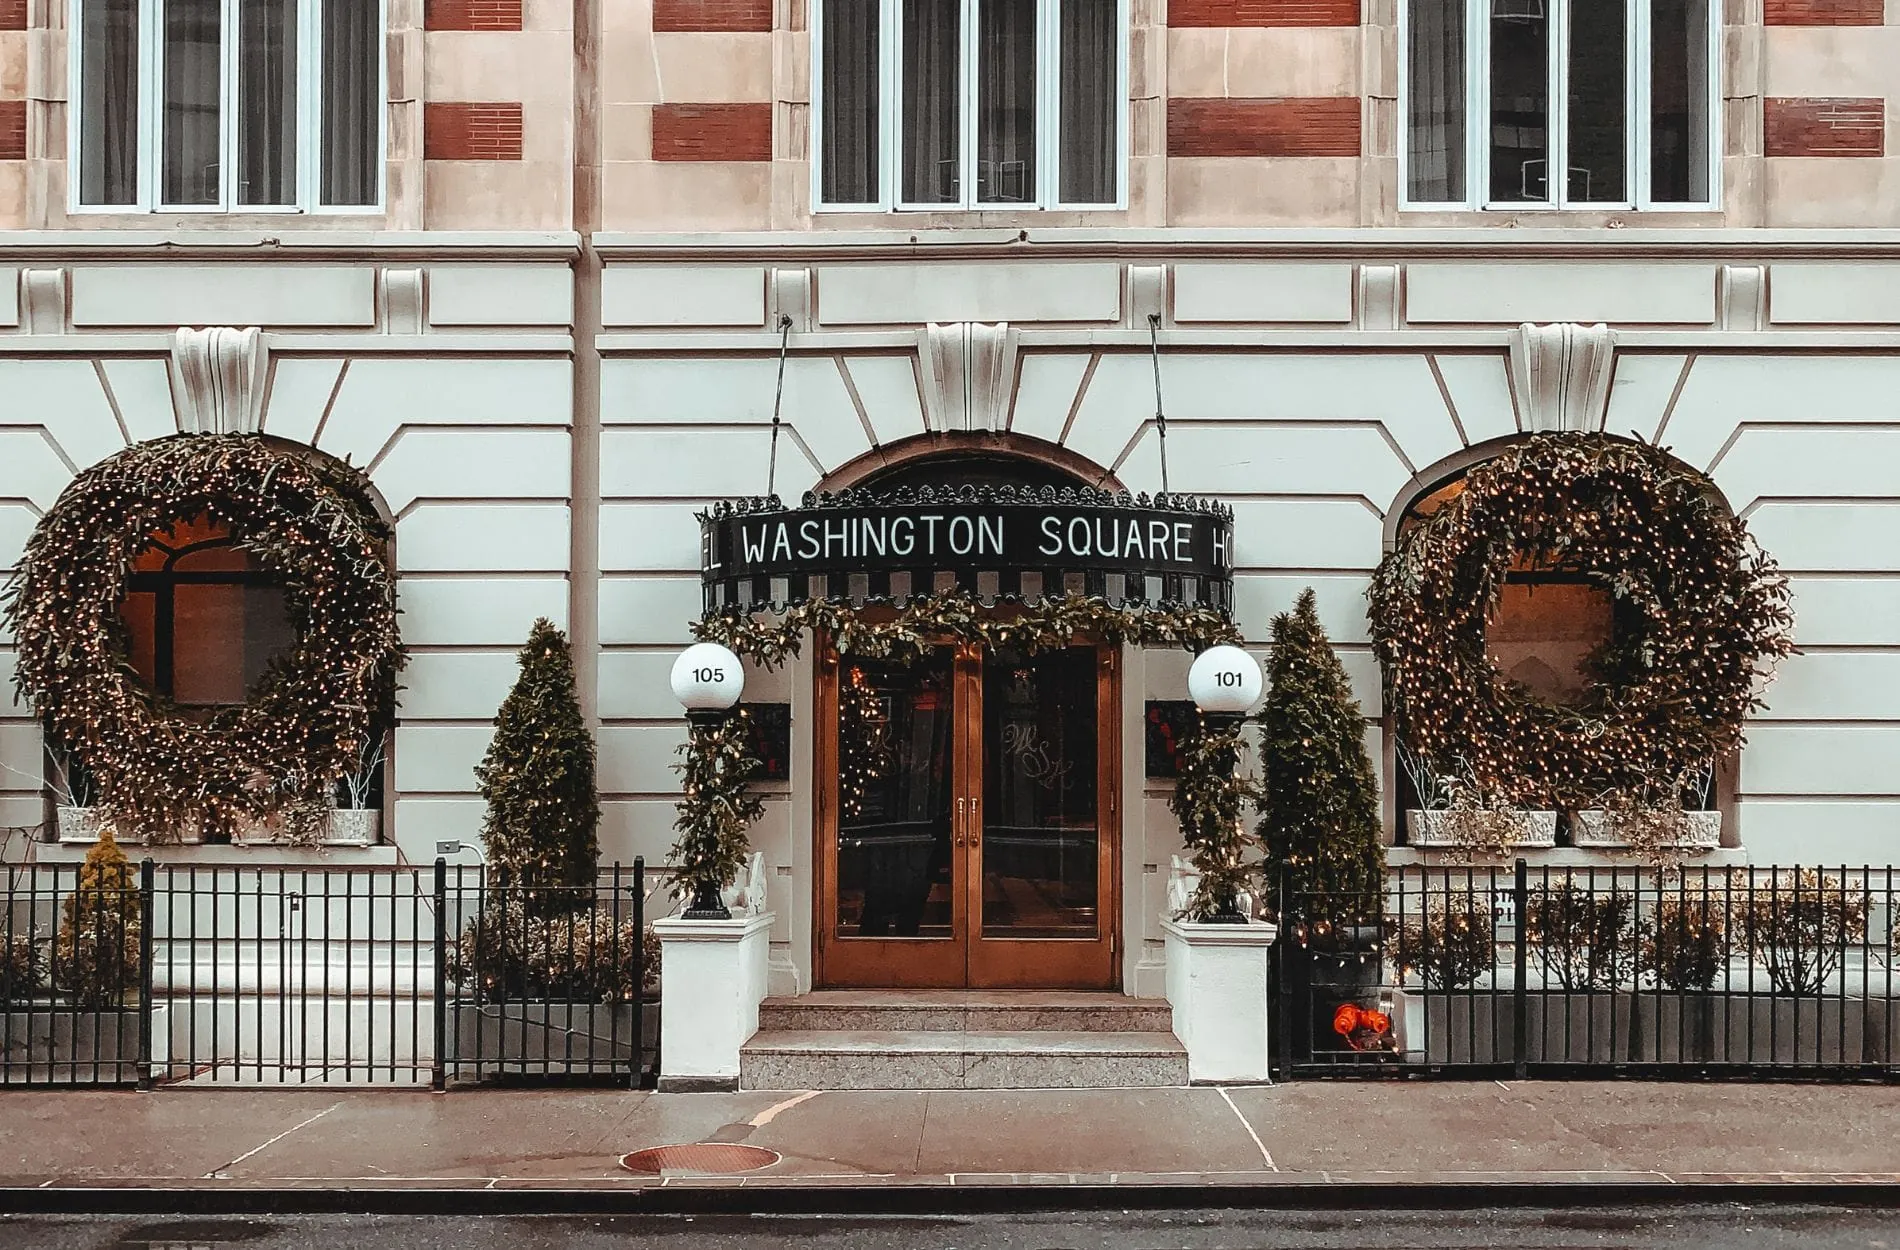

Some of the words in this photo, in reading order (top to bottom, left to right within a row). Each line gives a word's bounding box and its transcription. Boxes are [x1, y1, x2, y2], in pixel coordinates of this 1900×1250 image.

[742, 515, 1003, 564] WASHINGTON
[1038, 516, 1193, 562] SQUARE
[692, 667, 725, 683] 105
[1214, 671, 1242, 688] 101
